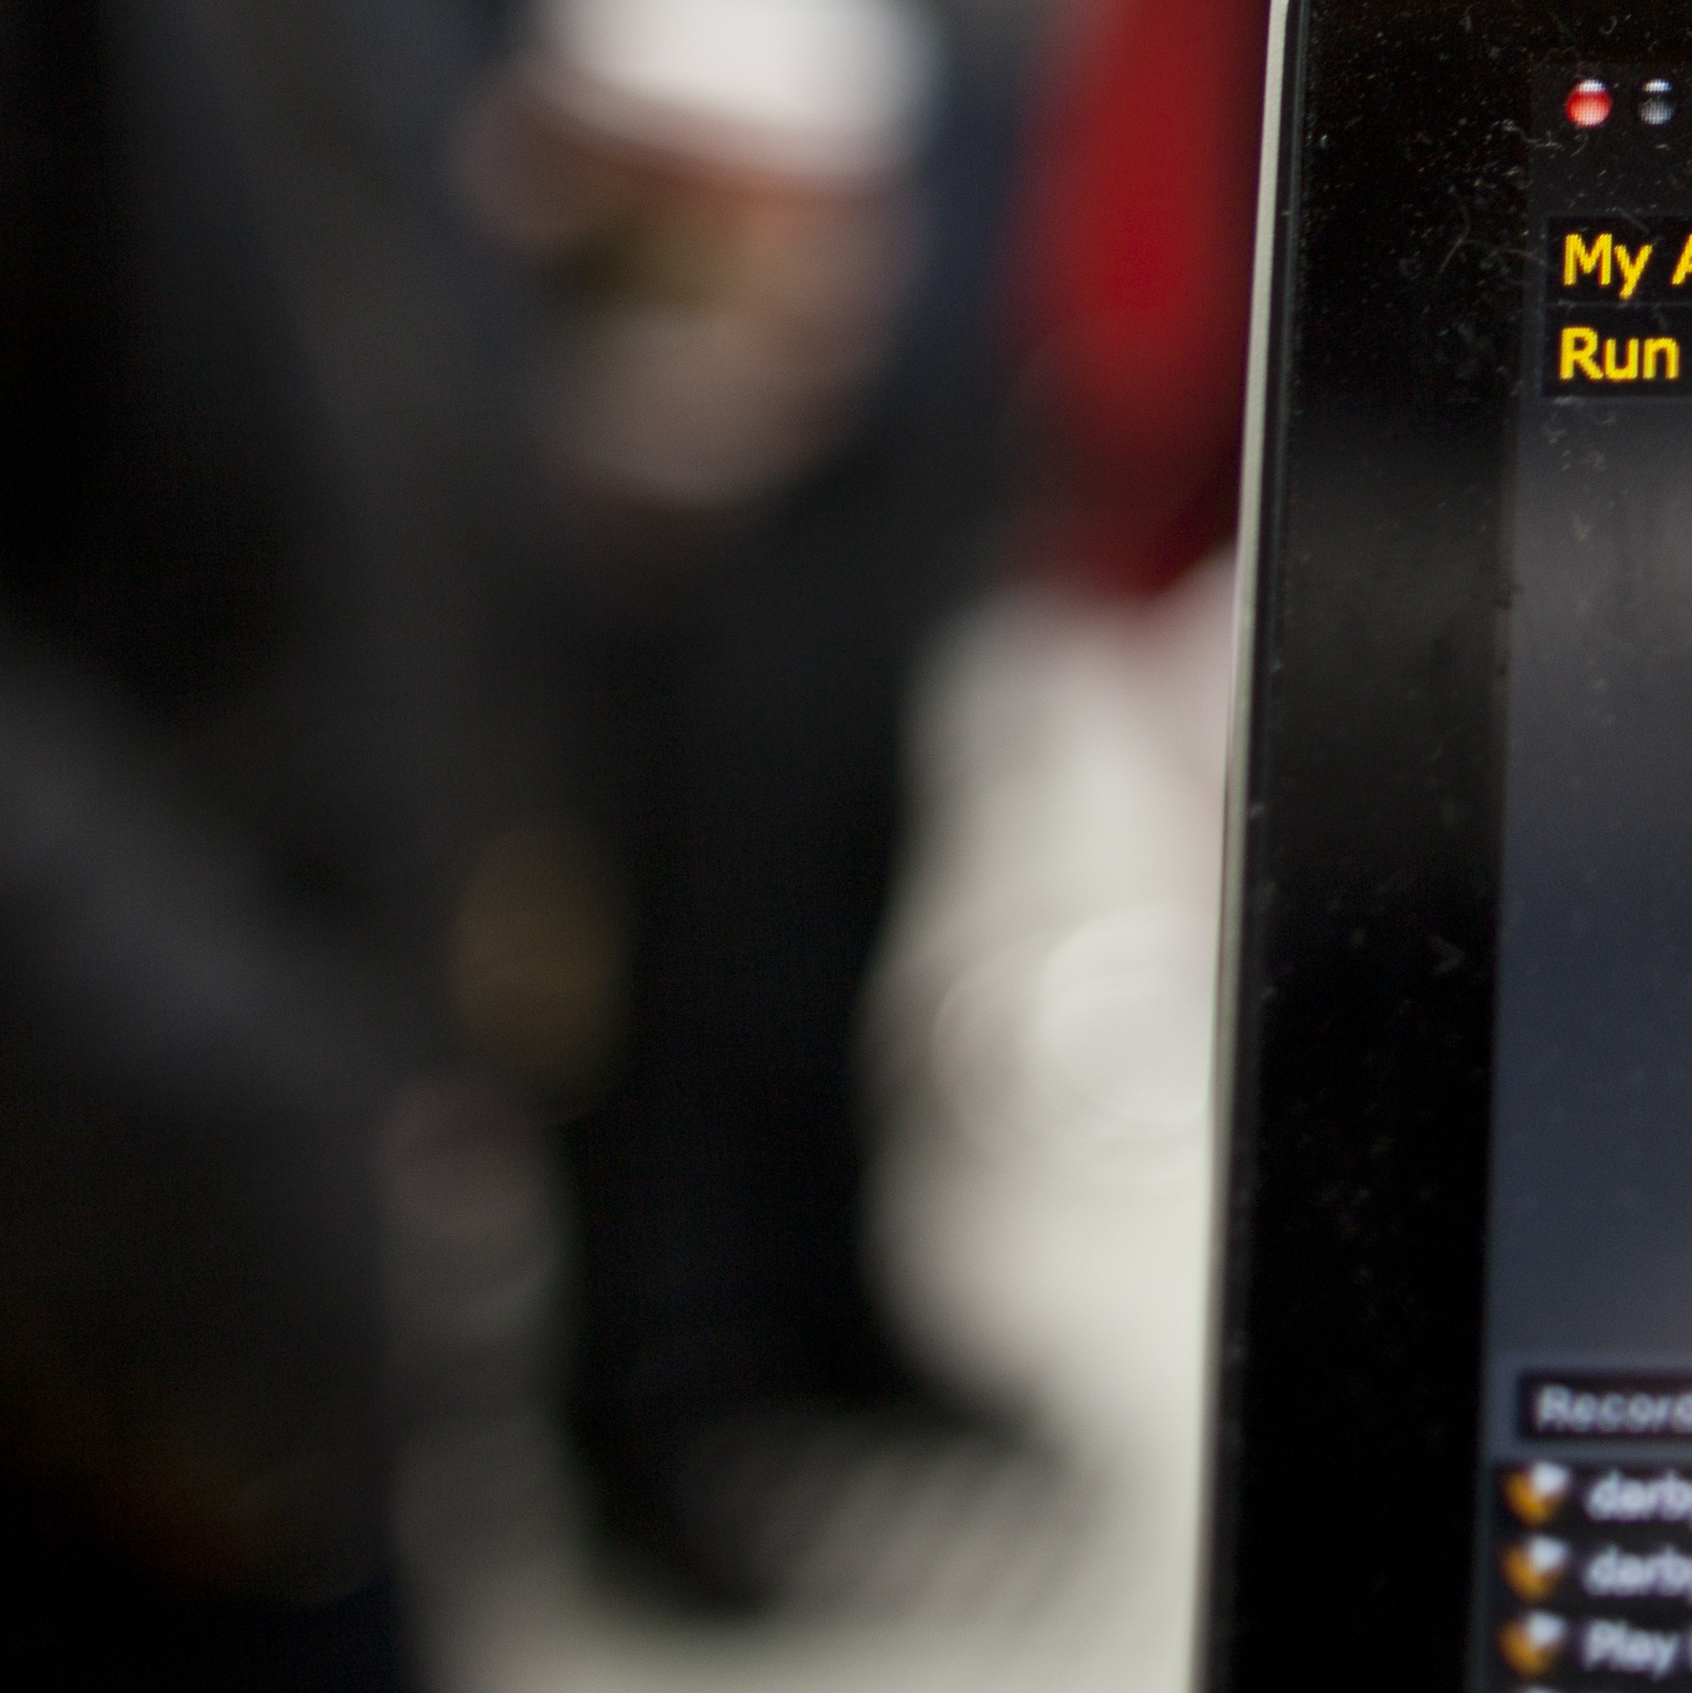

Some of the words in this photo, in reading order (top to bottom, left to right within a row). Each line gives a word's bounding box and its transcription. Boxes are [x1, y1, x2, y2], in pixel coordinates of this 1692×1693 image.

[1563, 234, 1652, 298] My
[1560, 328, 1680, 380] Run
[1584, 1619, 1680, 1681] Play
